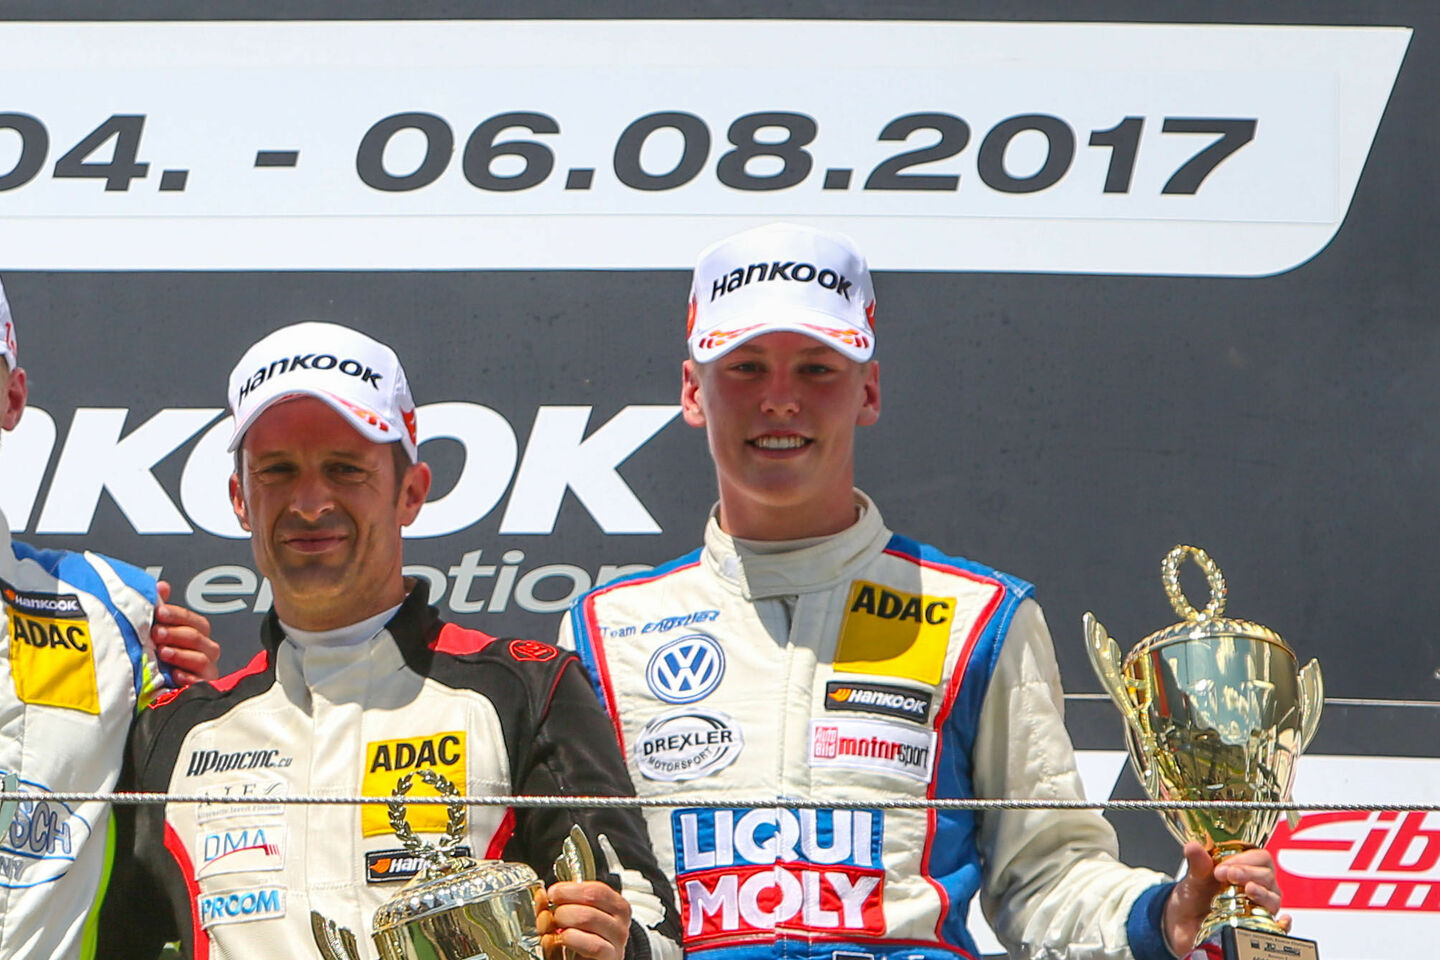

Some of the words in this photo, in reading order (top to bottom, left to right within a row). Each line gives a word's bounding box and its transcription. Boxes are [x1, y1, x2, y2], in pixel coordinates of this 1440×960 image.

[359, 110, 1258, 196] 06.08.2017
[851, 585, 950, 625] ADAC
[13, 614, 88, 652] ADAC
[370, 735, 461, 773] ADAC
[644, 730, 733, 756] DREXLER
[647, 747, 715, 773] MOTORSPORT
[204, 828, 267, 862] DMA
[680, 807, 874, 869] LIQUI
[684, 865, 880, 937] MOLY
